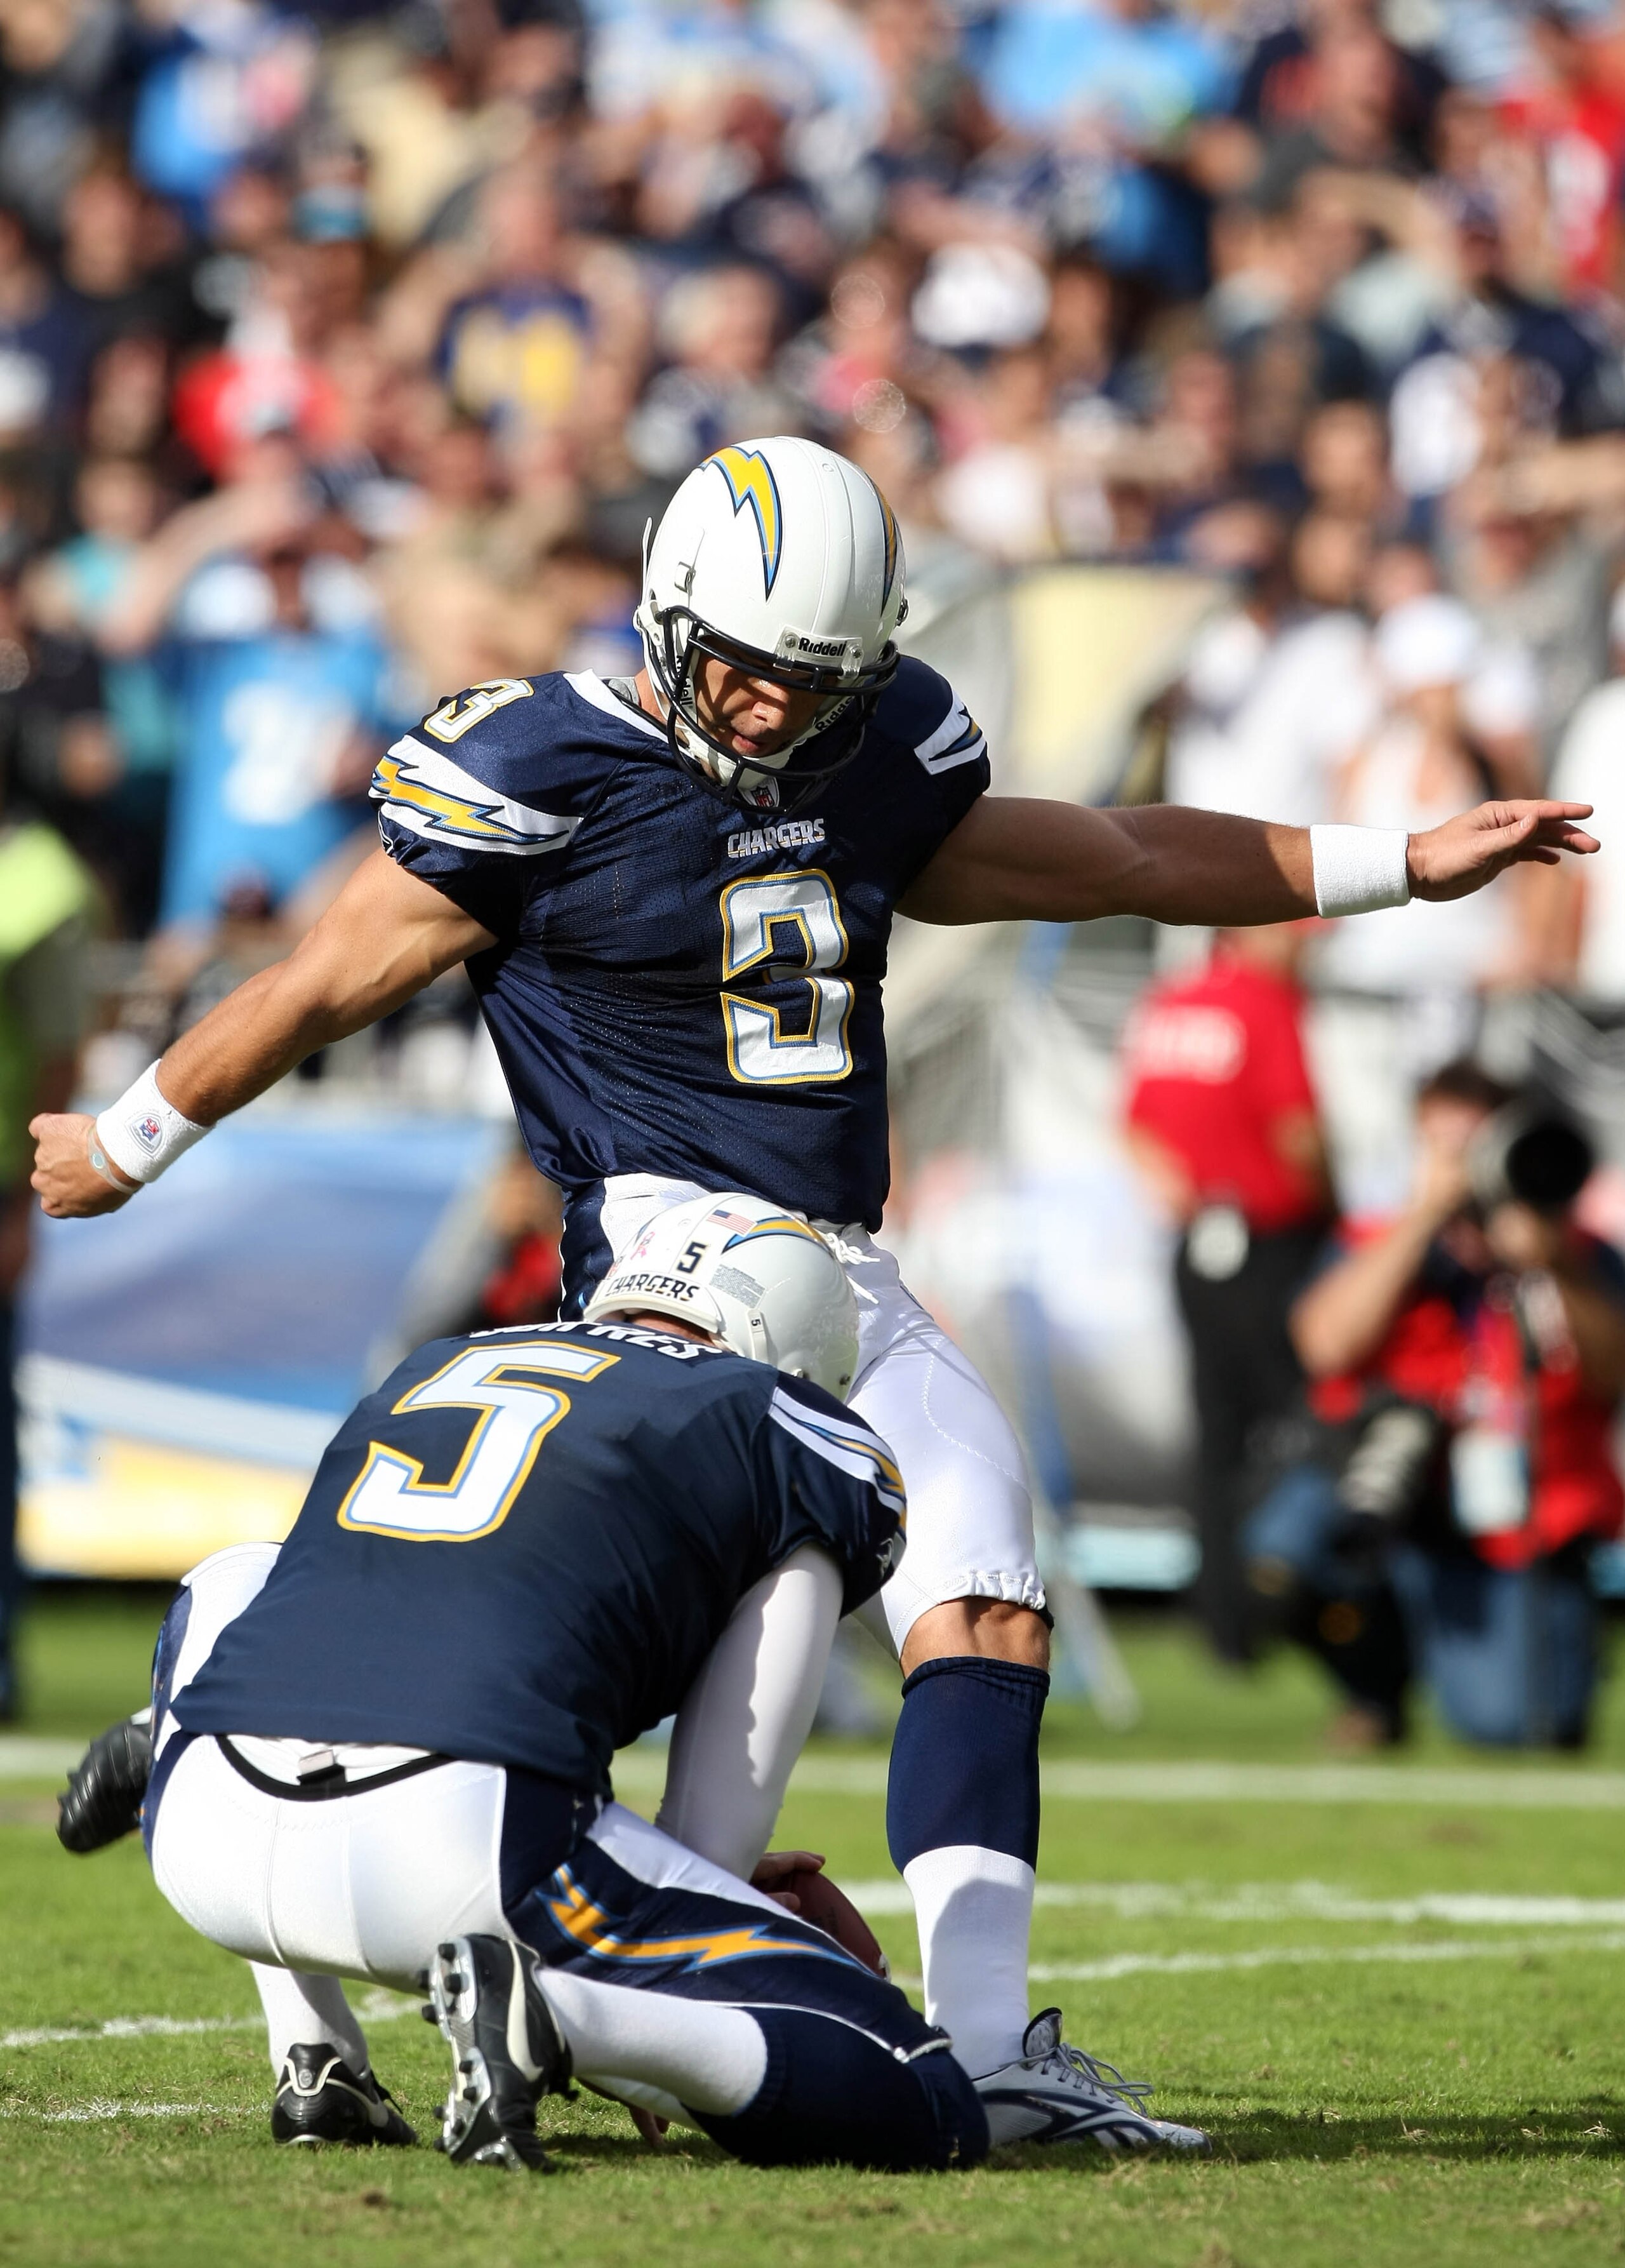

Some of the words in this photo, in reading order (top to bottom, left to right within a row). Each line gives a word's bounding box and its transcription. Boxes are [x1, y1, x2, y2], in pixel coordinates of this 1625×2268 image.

[798, 637, 847, 657] Riddell
[424, 678, 534, 743] 3
[728, 818, 825, 858] CHARGERS
[719, 869, 855, 1084] 3
[677, 1241, 708, 1274] 5
[605, 1274, 700, 1302] CHARGERS
[337, 1340, 622, 1543] 5
